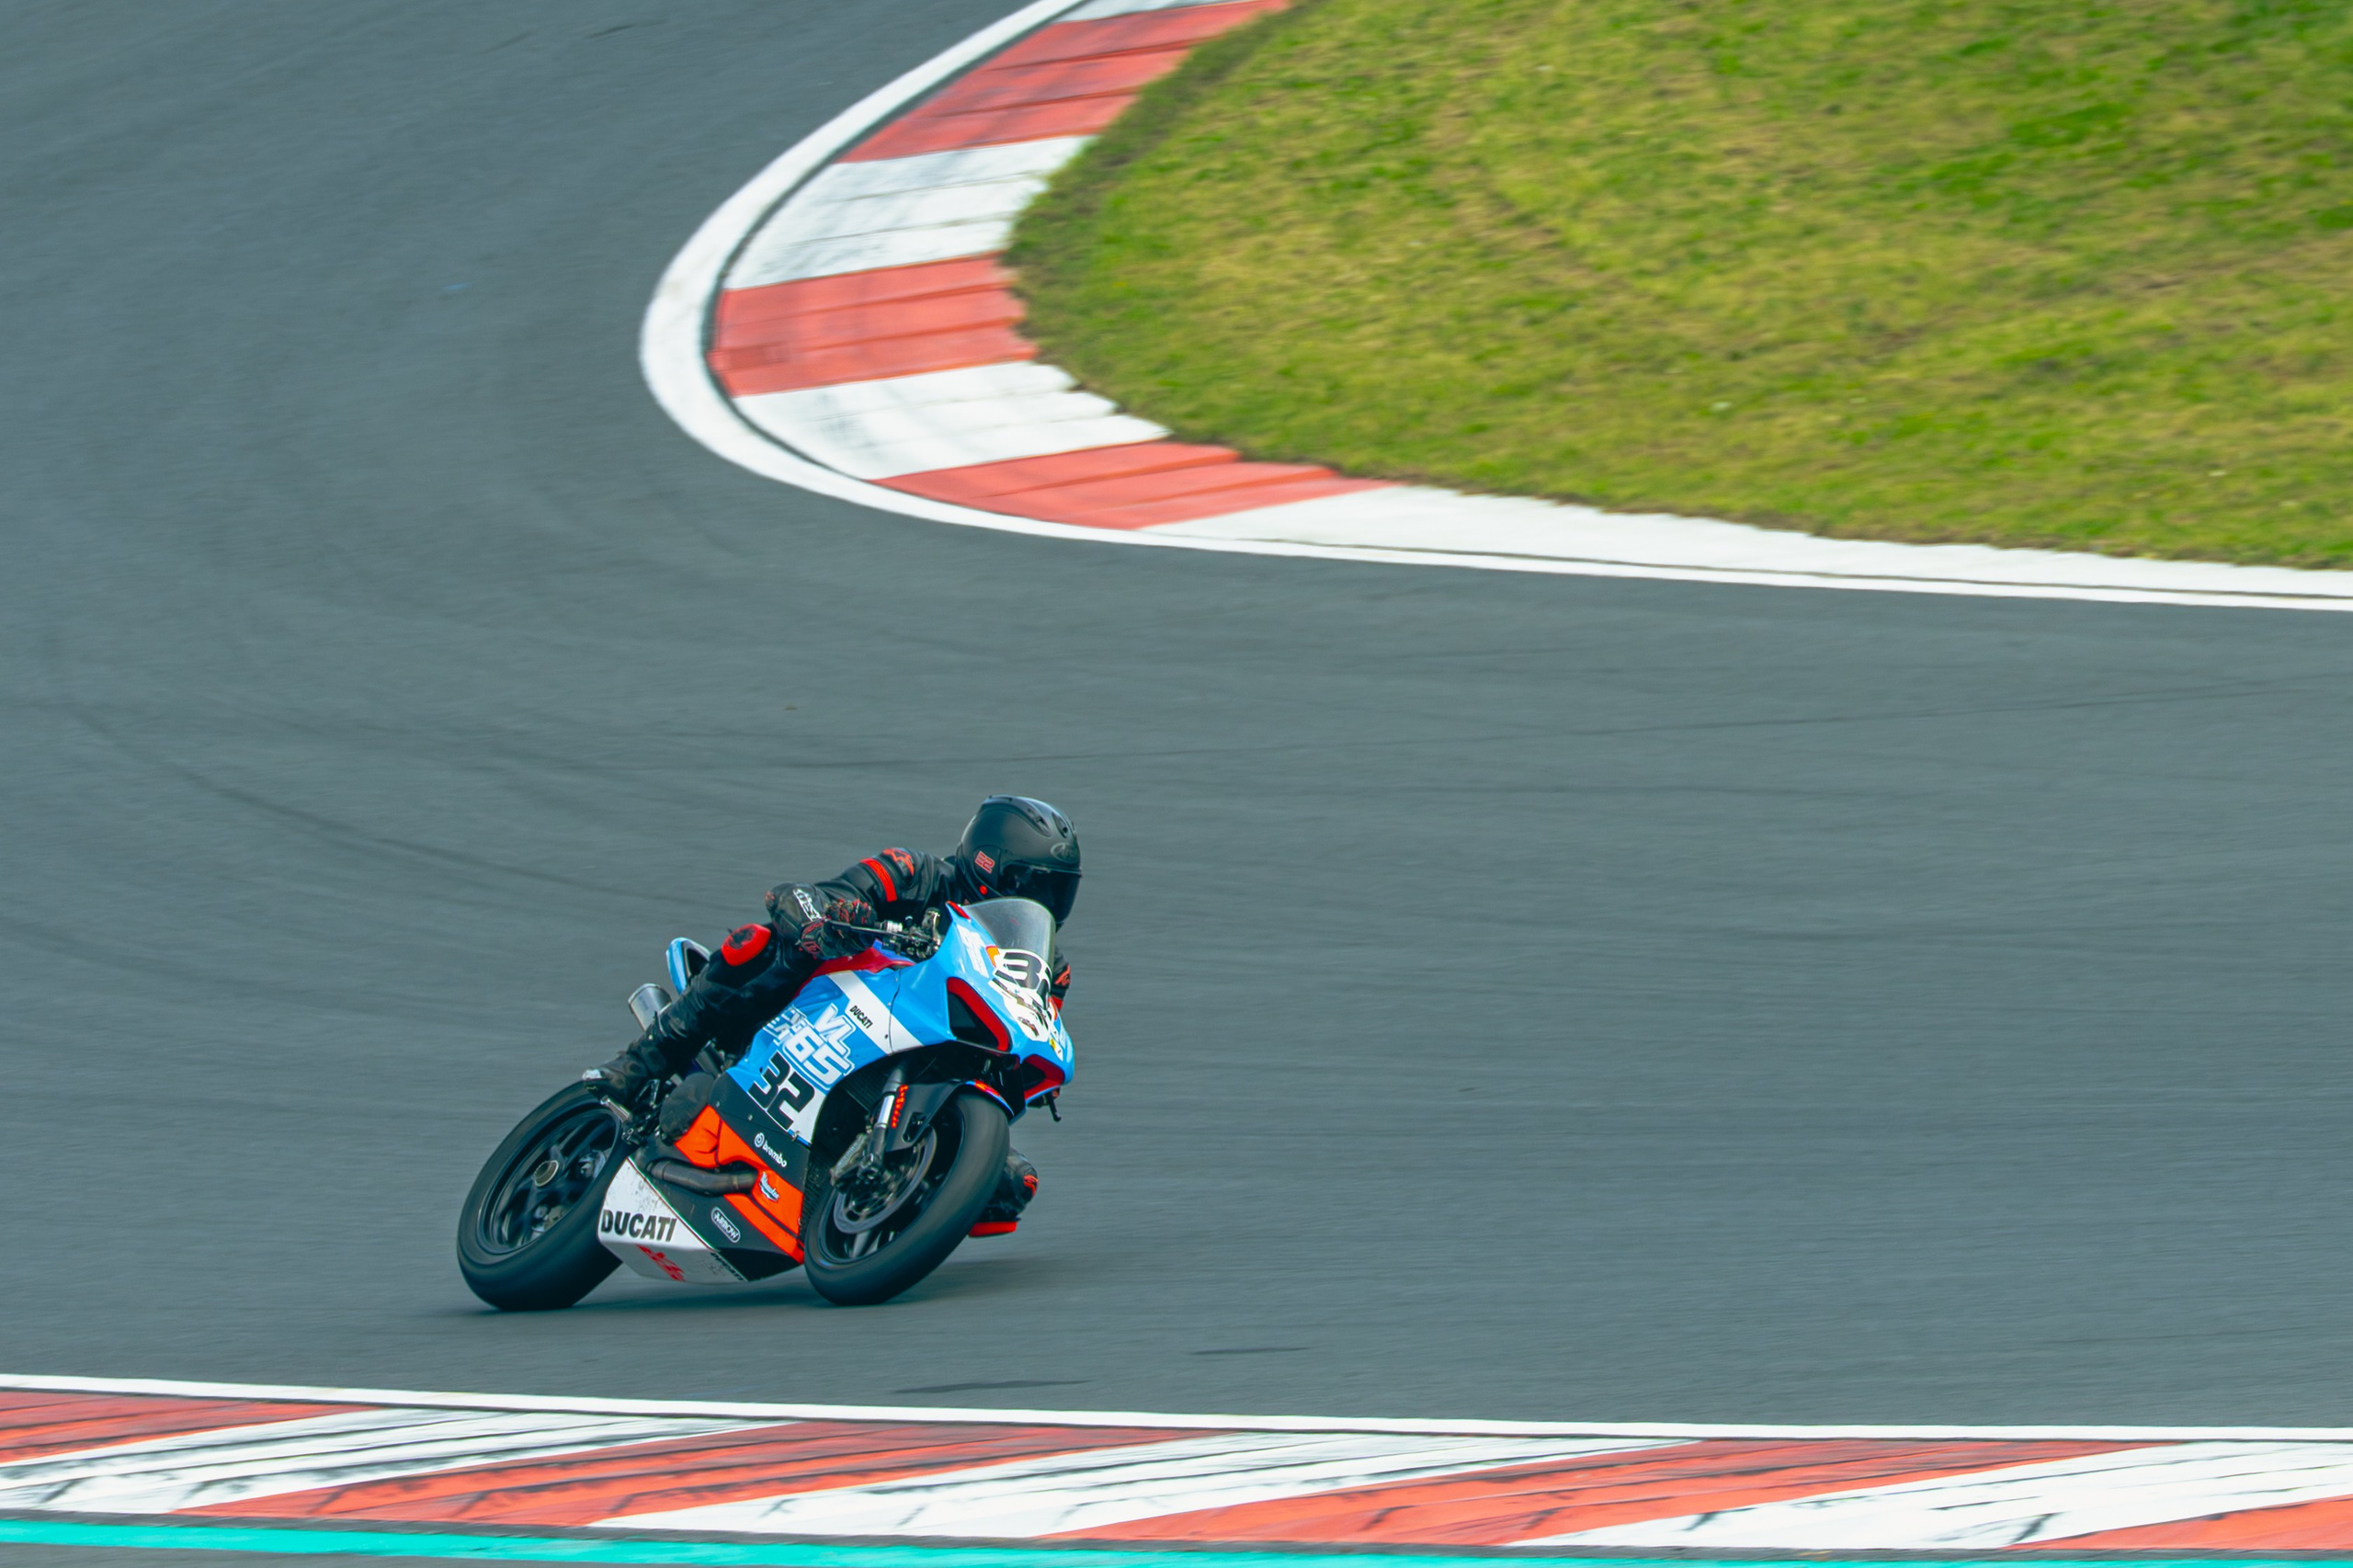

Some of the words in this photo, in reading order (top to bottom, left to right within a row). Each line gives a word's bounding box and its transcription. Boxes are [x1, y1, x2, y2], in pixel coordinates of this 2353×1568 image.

[849, 1005, 873, 1029] DUCATI
[748, 1051, 815, 1130] 32
[762, 1139, 788, 1168] brembo
[600, 1209, 676, 1242] DUCATI
[713, 1210, 739, 1243] ARROW
